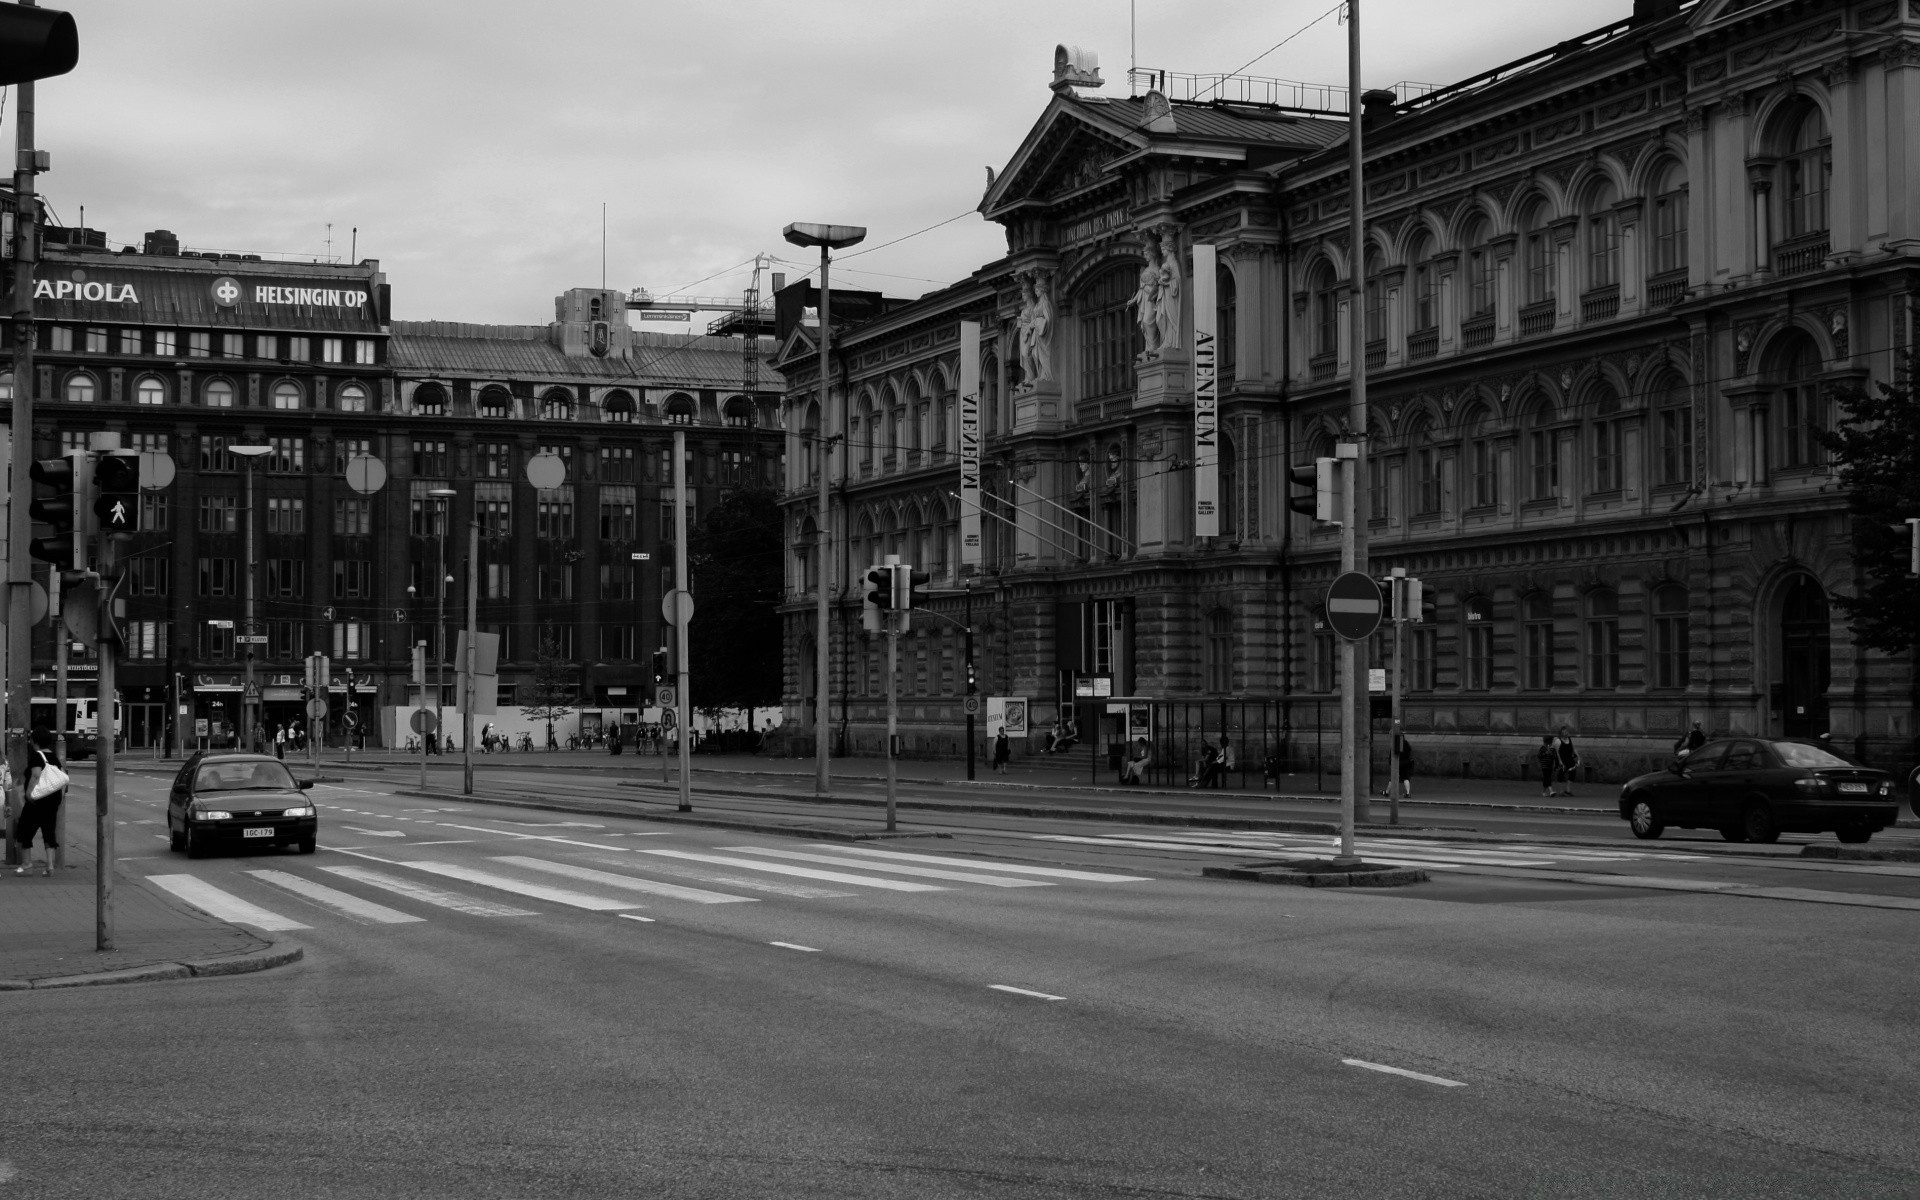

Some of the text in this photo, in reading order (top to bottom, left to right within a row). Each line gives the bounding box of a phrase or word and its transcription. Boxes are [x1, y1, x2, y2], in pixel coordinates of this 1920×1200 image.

[33, 279, 139, 303] APIOLA
[256, 285, 367, 308] HELSINGIN OP
[1196, 330, 1215, 447] ATENEUM
[661, 693, 671, 701] 40
